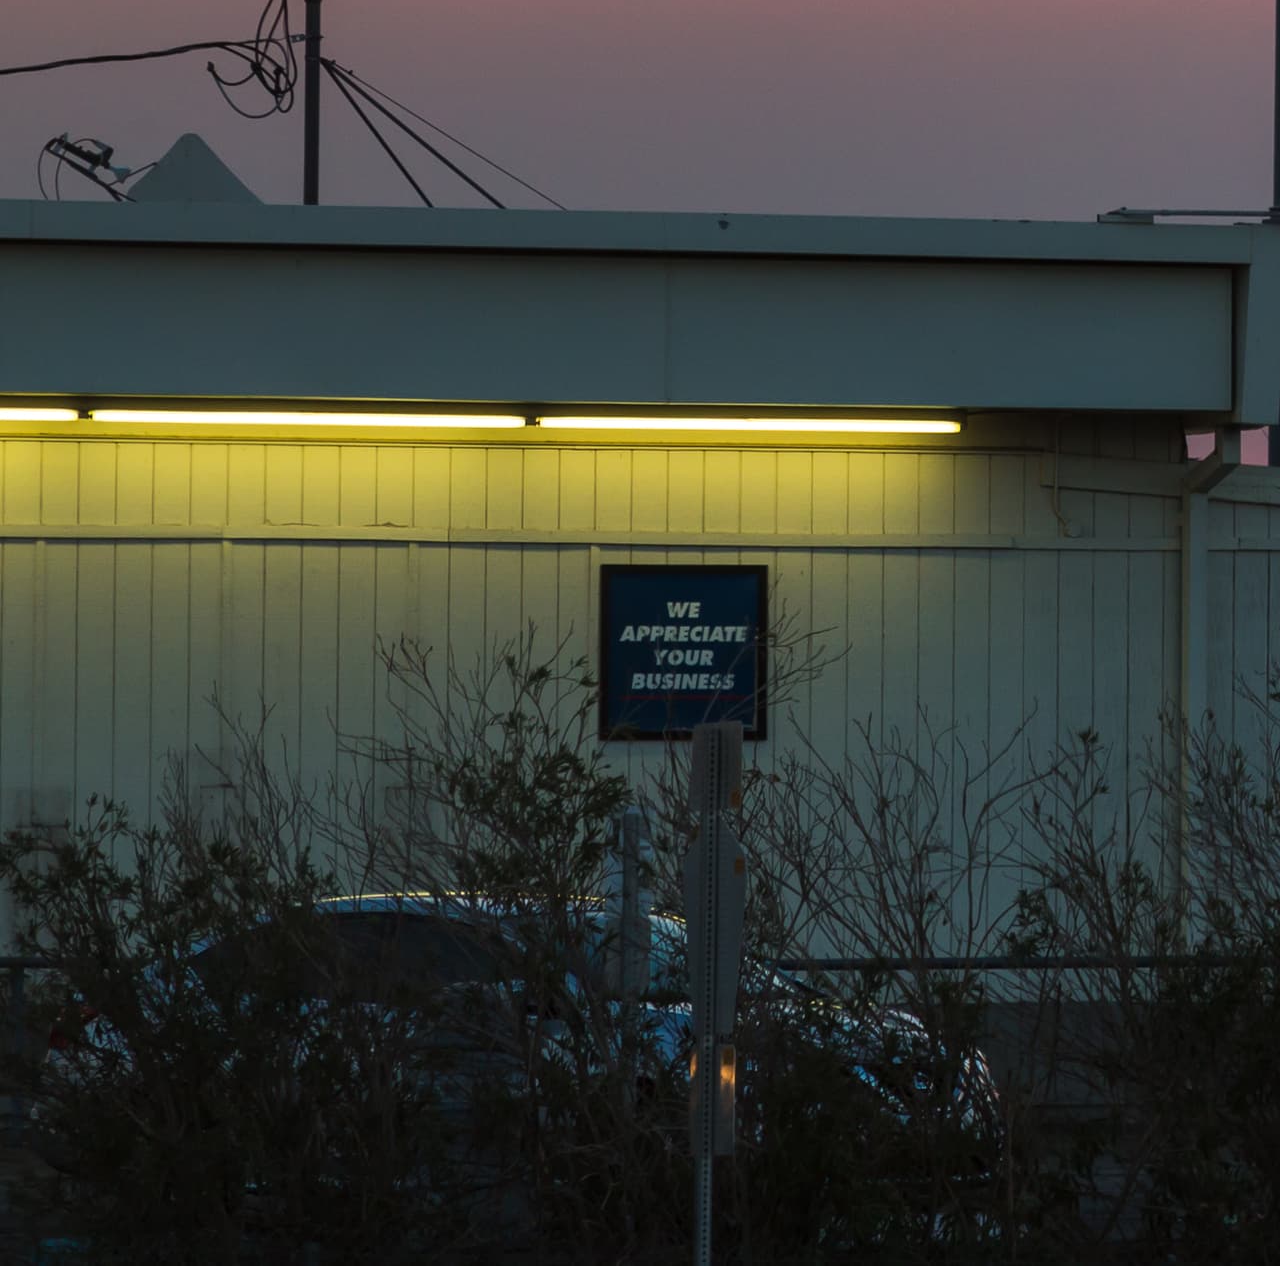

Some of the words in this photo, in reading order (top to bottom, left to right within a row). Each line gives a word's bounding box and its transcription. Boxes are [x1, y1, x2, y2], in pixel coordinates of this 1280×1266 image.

[667, 602, 700, 618] WE
[619, 625, 747, 642] APPRECIATE
[654, 649, 714, 666] YOUR
[631, 673, 735, 689] BUSINESS
